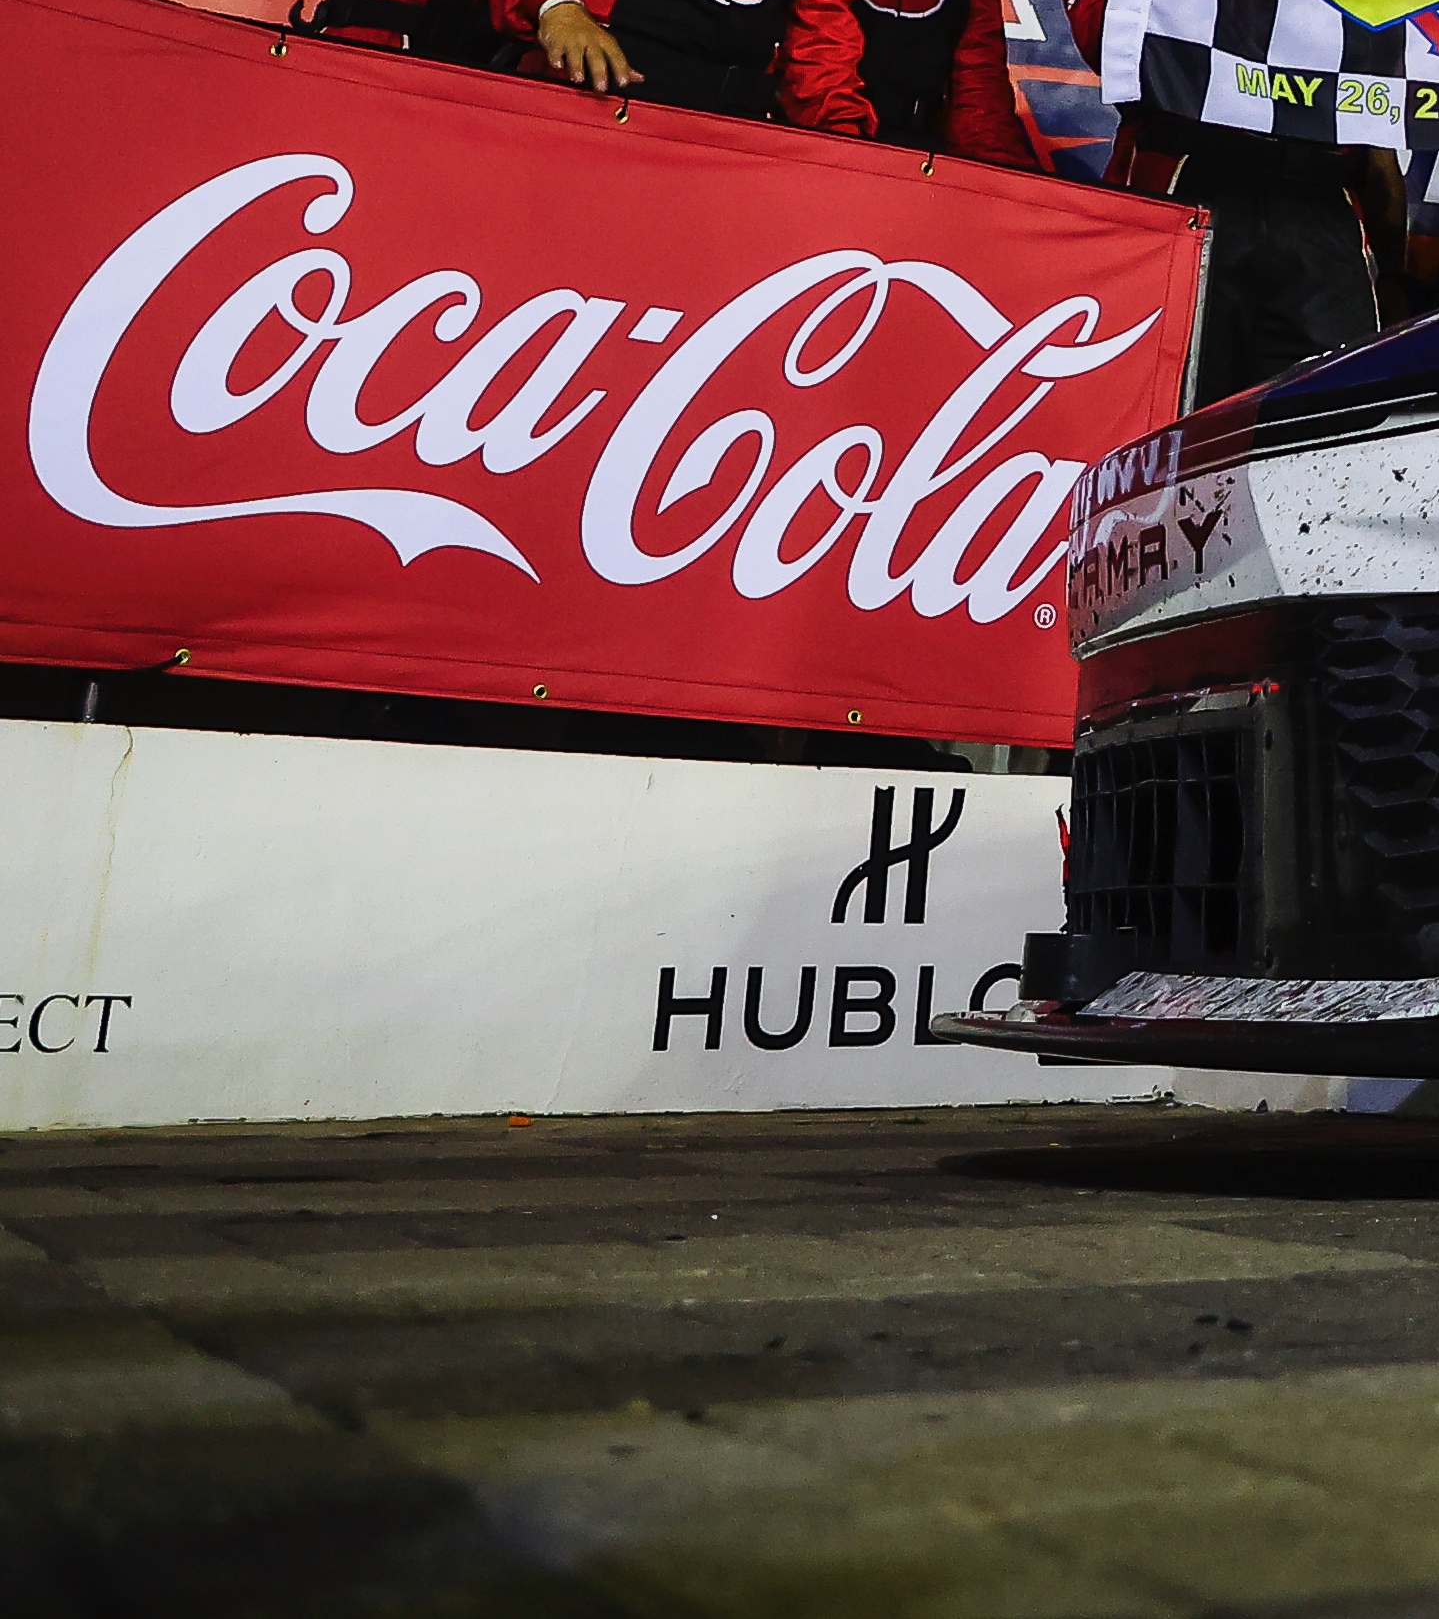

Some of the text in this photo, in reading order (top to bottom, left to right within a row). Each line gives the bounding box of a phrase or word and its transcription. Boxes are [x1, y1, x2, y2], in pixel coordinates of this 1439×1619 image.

[1236, 64, 1323, 108] MAY
[1336, 80, 1401, 124] 26,
[28, 153, 1163, 625] Coca-Cola
[1068, 510, 1224, 608] AMRY
[652, 964, 1021, 1052] HUBL
